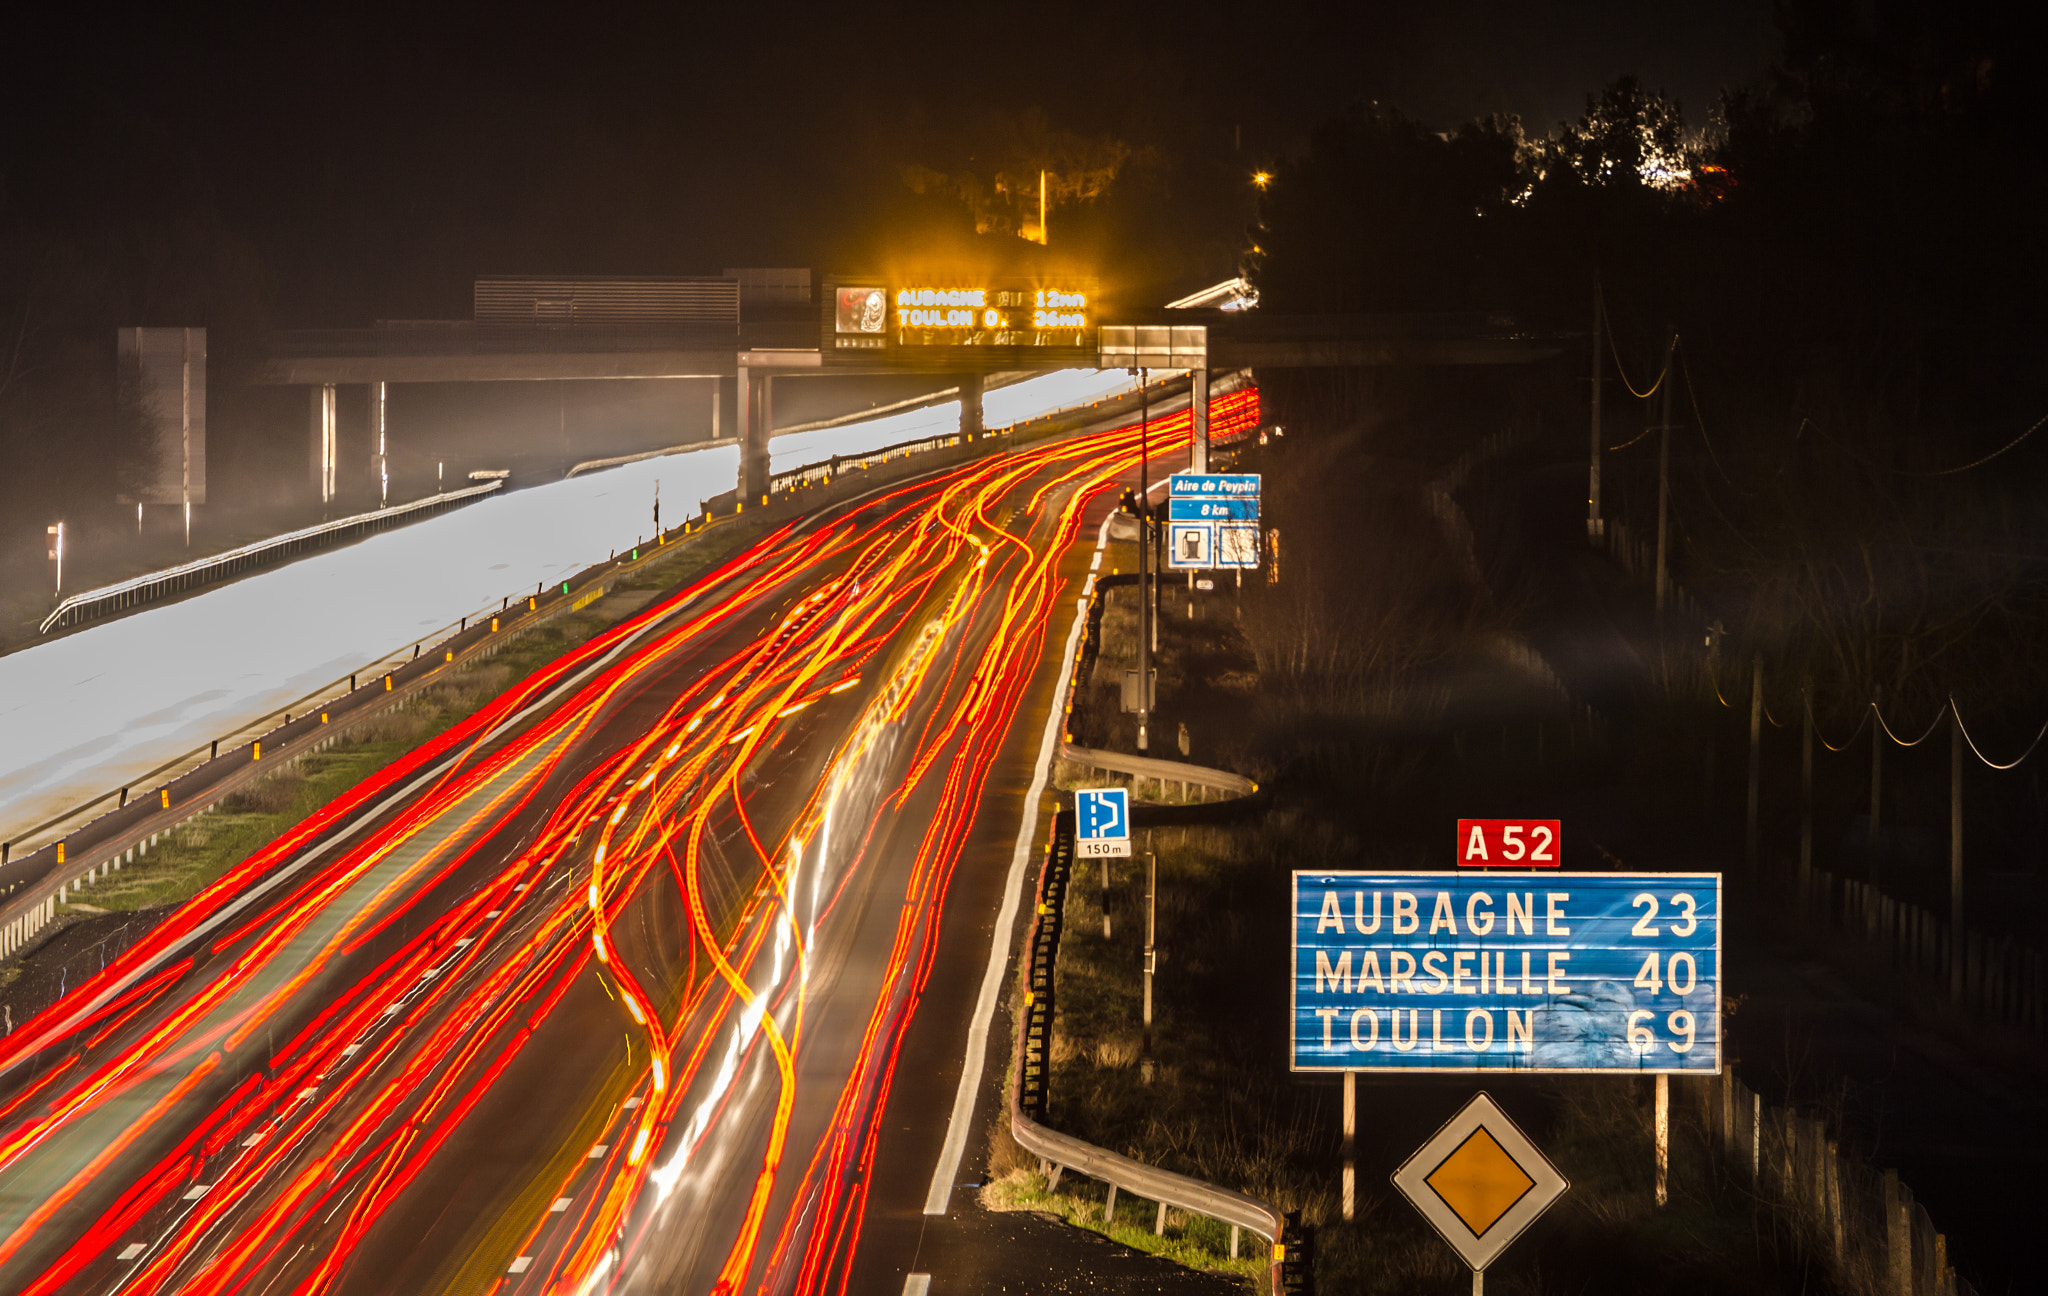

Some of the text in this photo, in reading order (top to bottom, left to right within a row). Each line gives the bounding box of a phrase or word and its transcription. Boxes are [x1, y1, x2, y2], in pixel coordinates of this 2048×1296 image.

[897, 290, 985, 307] AUBAGNE
[897, 309, 973, 327] TOULON
[1174, 479, 1256, 494] Aire de Peypin
[1200, 504, 1229, 516] 8 km
[1086, 844, 1121, 855] 150 m
[1465, 825, 1553, 861] A 52
[1316, 890, 1698, 938] AUBAGNE 23
[1315, 950, 1697, 996] MARSEILLE 40
[1315, 1008, 1697, 1054] TOULON 69
